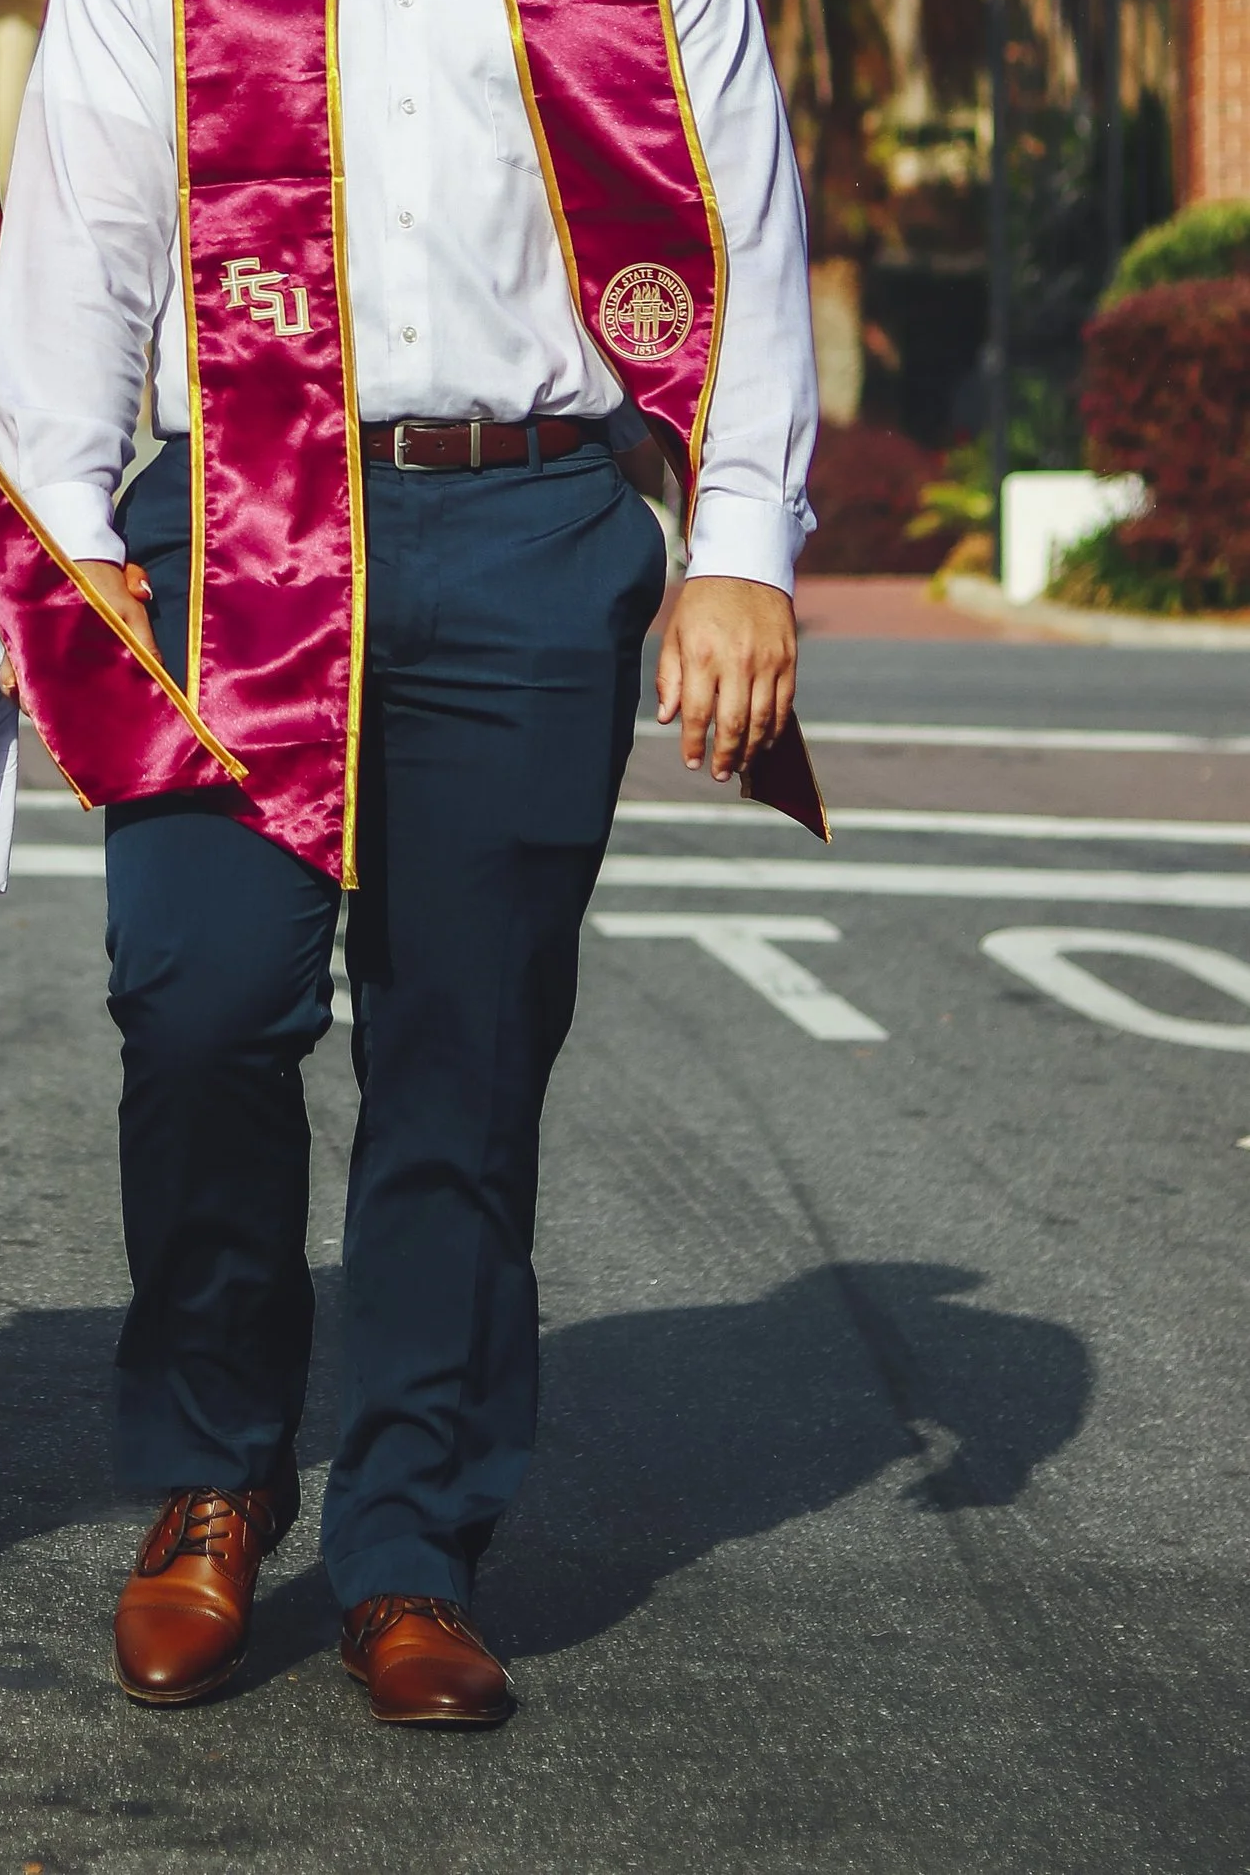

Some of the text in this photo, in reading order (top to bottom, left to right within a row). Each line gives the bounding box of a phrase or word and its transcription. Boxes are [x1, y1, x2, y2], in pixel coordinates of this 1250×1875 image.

[219, 257, 315, 337] FSU
[605, 269, 688, 338] FLORIDA STATE UNIVERSITY
[633, 345, 658, 356] 1851
